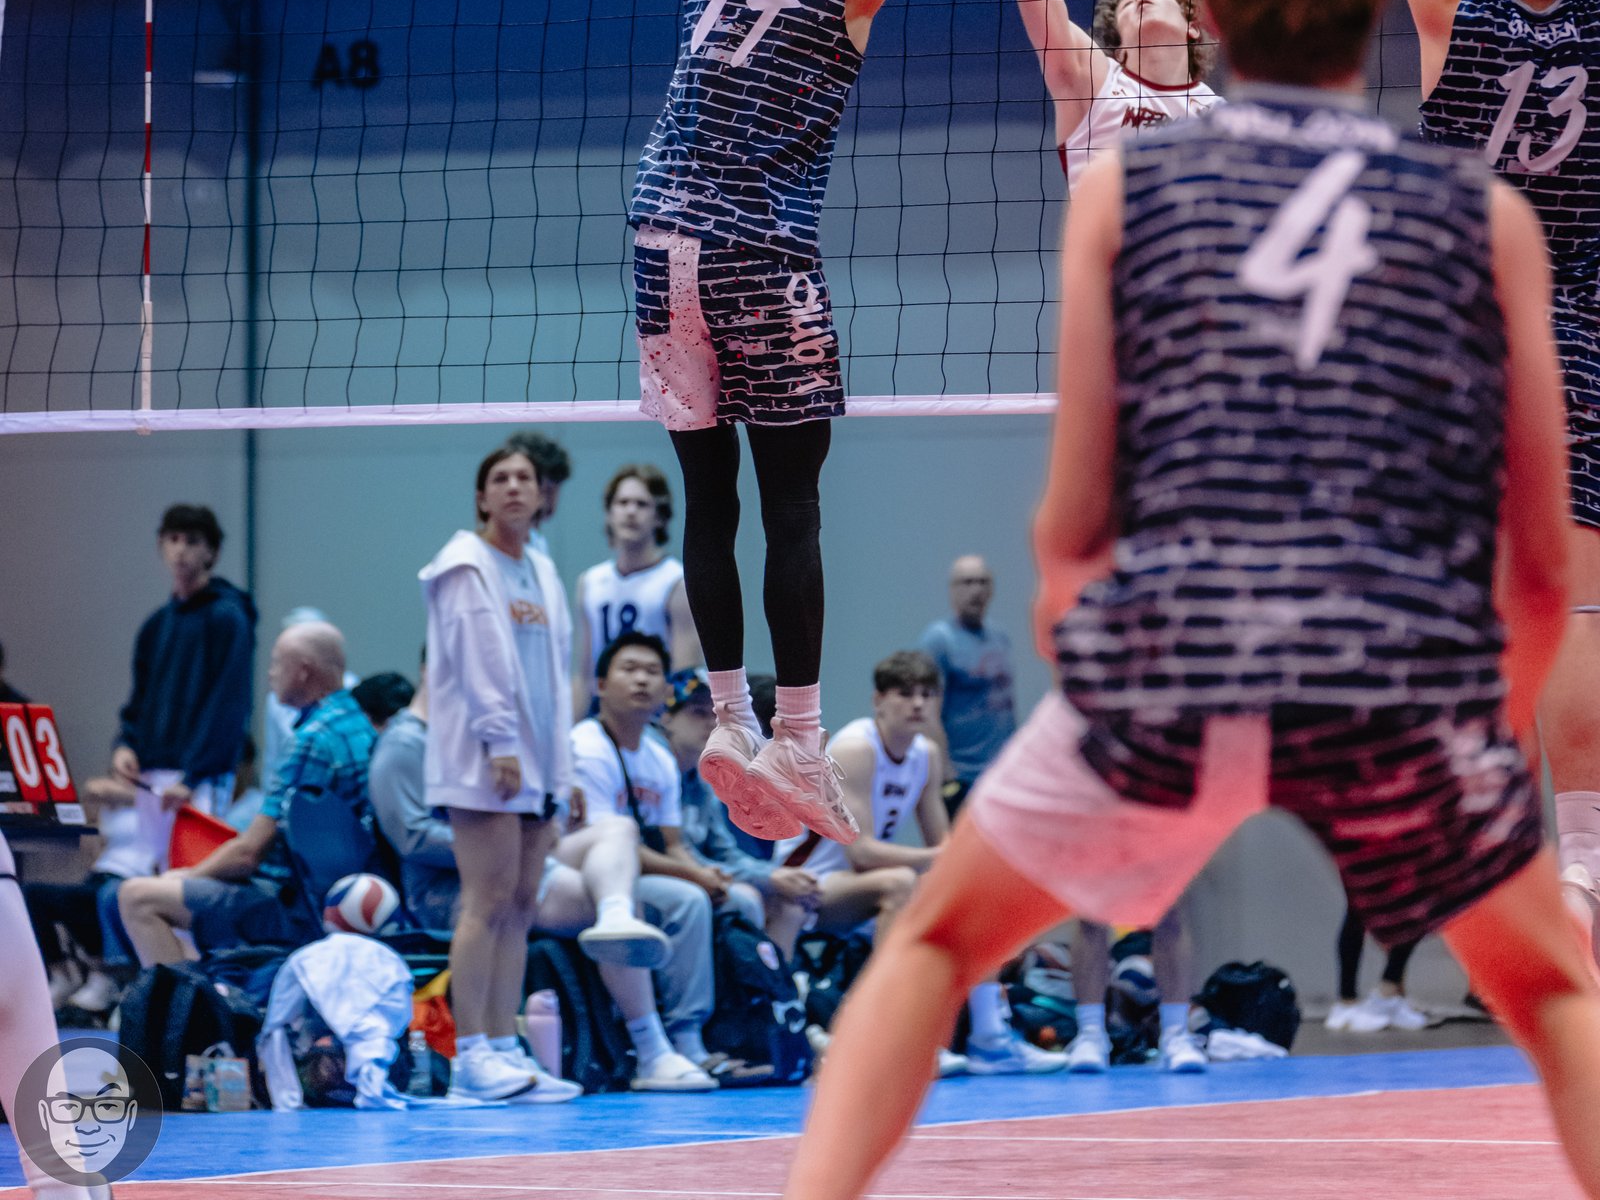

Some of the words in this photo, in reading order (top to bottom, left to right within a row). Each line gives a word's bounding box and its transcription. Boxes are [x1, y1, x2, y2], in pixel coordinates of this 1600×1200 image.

[311, 41, 380, 91] A8
[1486, 60, 1589, 172] 13
[1240, 148, 1377, 371] 4
[6, 714, 69, 789] 03
